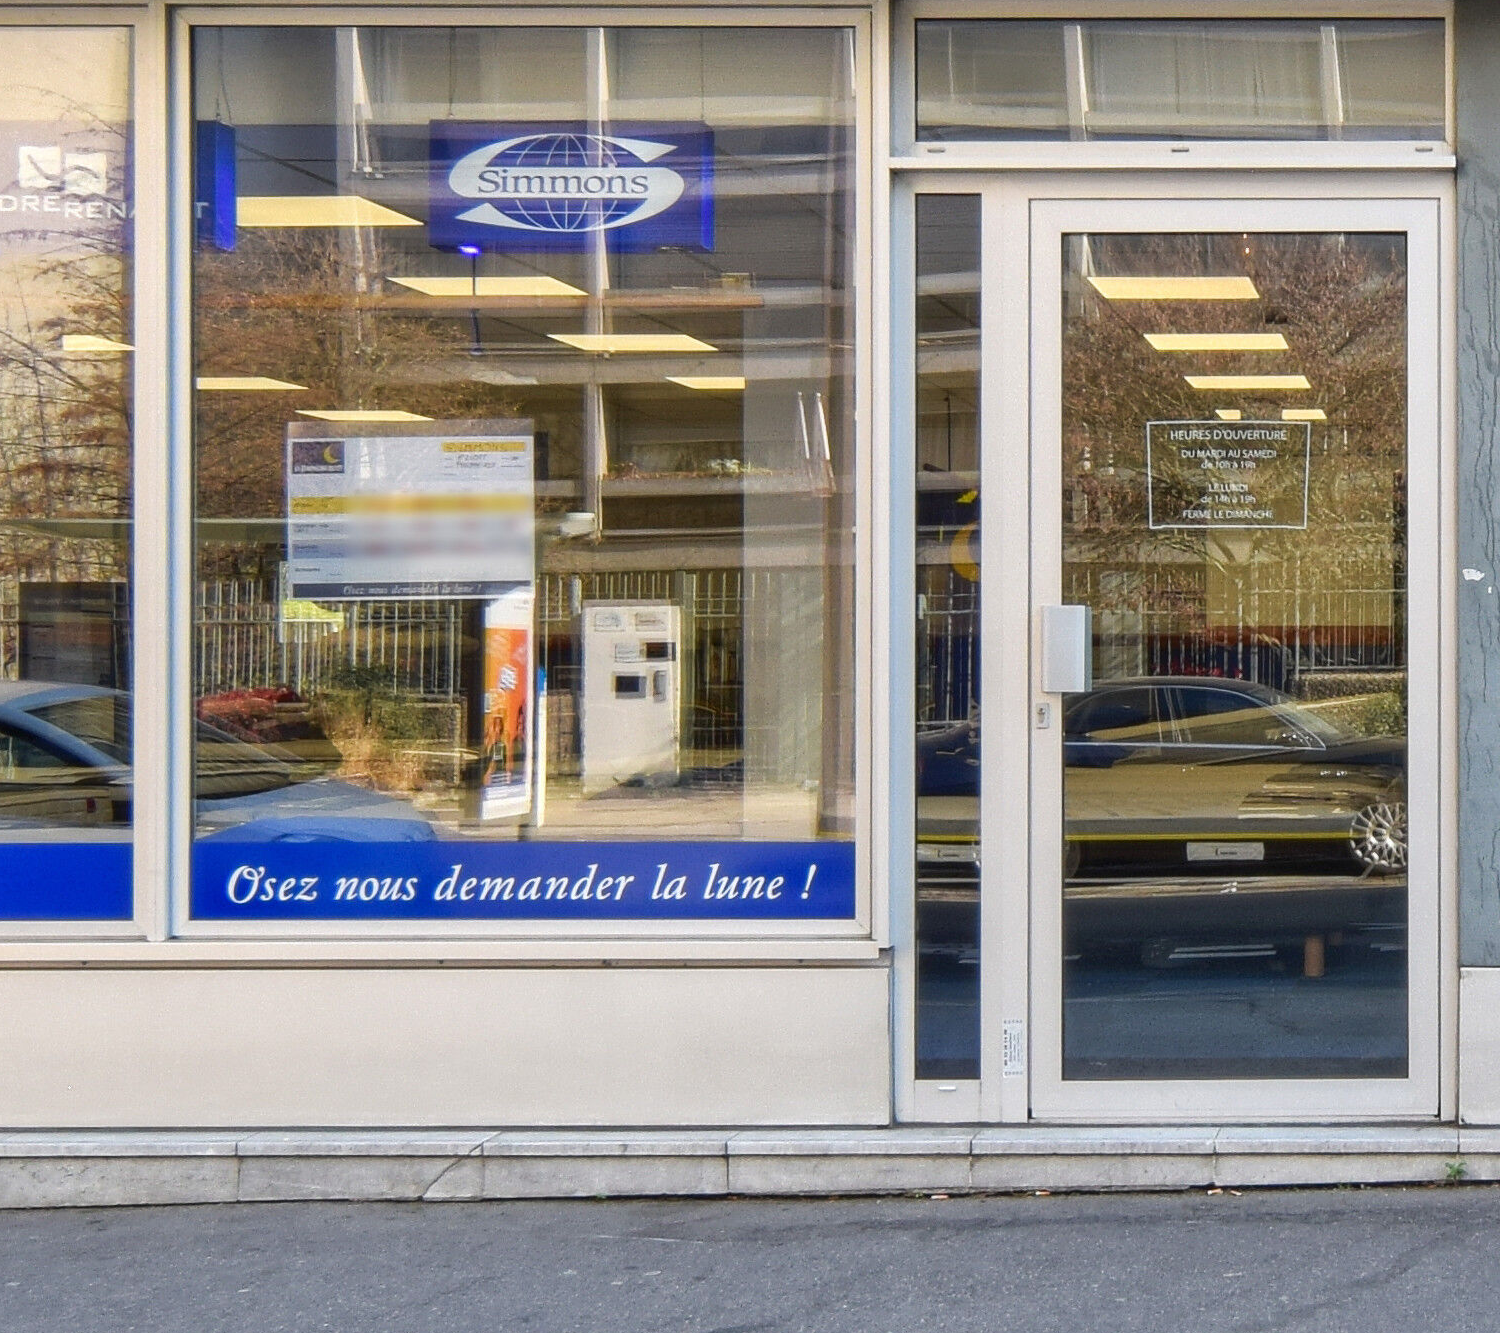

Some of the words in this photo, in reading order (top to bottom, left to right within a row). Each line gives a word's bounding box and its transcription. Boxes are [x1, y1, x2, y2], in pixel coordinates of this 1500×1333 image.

[478, 169, 648, 194] Simmons
[1170, 430, 1211, 441] HEURES
[1213, 430, 1287, 441] D'OUVERTURE
[228, 865, 319, 904] Osez
[335, 878, 418, 902] nous
[434, 863, 636, 902] demander
[652, 863, 688, 900] la
[704, 862, 785, 900] lune
[801, 863, 817, 900] !
